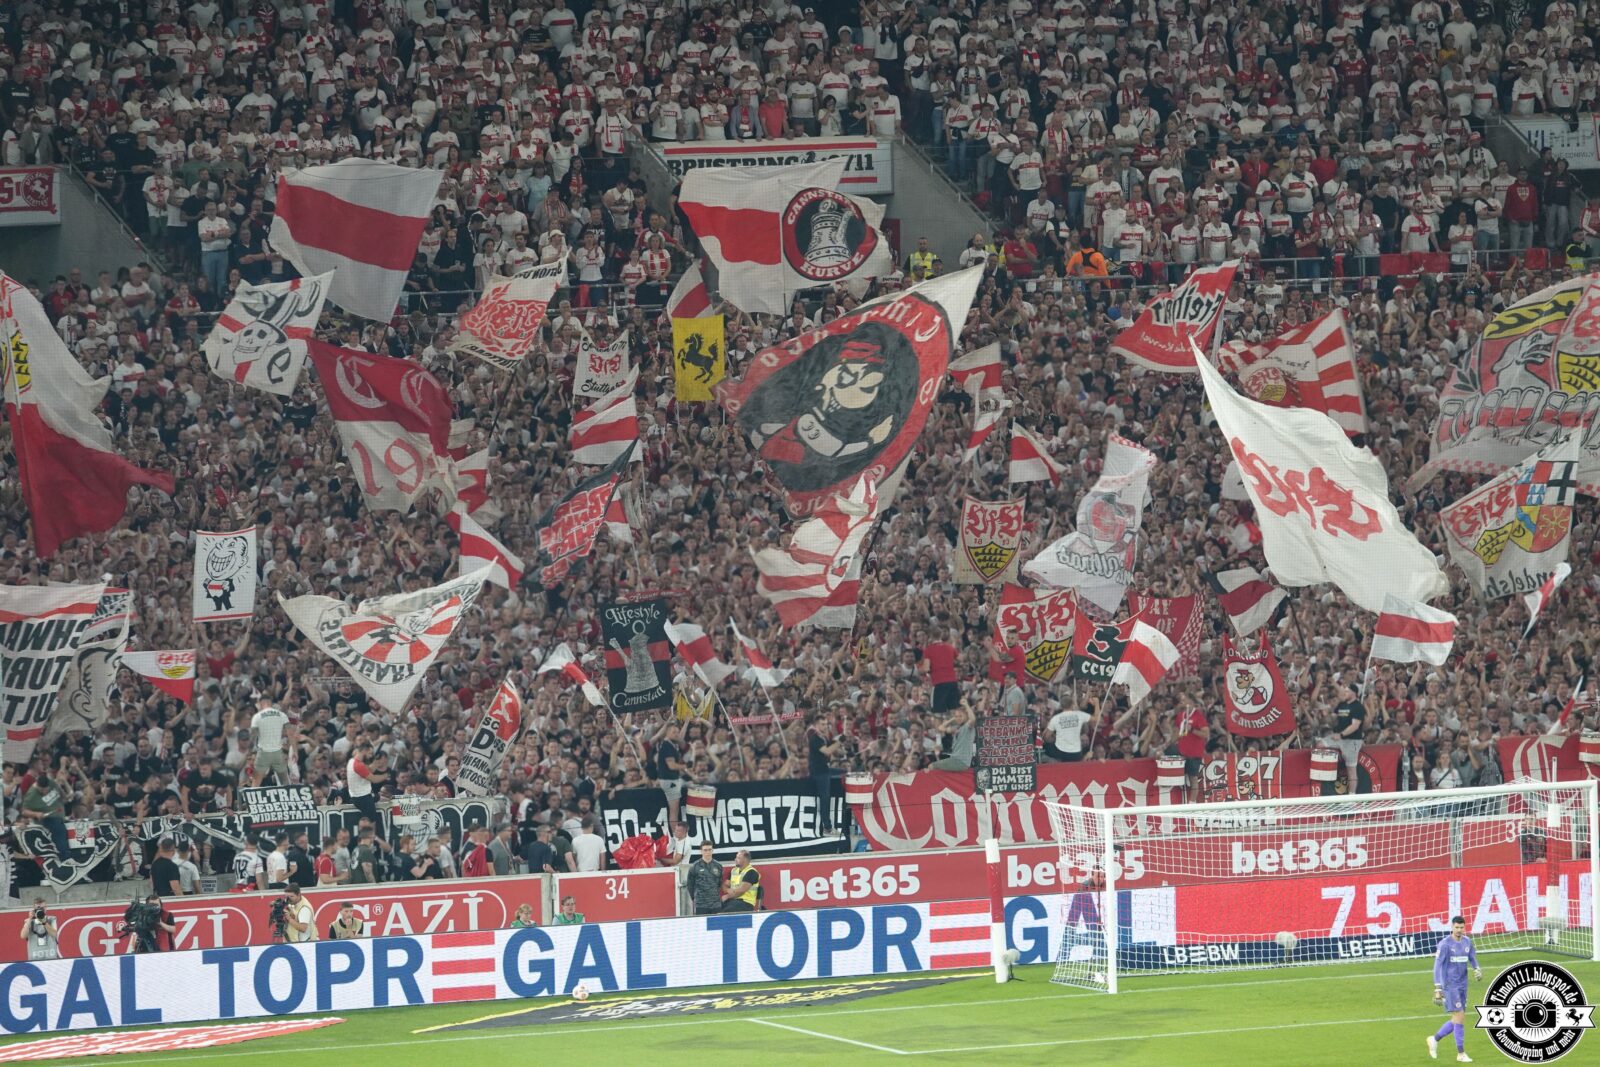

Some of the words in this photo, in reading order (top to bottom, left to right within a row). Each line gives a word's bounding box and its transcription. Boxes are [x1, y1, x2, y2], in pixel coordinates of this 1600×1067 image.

[800, 251, 864, 277] KURVE
[589, 353, 622, 375] VfB
[965, 503, 1023, 538] VfB
[606, 604, 660, 627] Lifestyle
[1000, 591, 1075, 642] VfB
[612, 685, 666, 708] Cannstatt
[1231, 706, 1282, 728] Cannstatt
[984, 735, 1029, 747] KEHRT
[992, 767, 1006, 776] DU
[1011, 766, 1033, 775] BIST
[1237, 756, 1280, 780] 97
[992, 775, 1033, 784] IMMER
[992, 784, 1008, 792] BEI
[1011, 783, 1034, 792] UNS!
[1372, 783, 1381, 793] 97
[246, 786, 314, 805] ULTRAS
[1311, 785, 1321, 797] 19
[249, 799, 315, 814] BEDEUTET
[251, 809, 318, 824] WIDERSTAND
[604, 806, 674, 855] 50+1
[1232, 836, 1368, 874] bet365
[605, 877, 630, 900] 34
[780, 865, 920, 902] bet365
[1321, 883, 1402, 937] 75
[32, 949, 56, 957] FOTO
[0, 955, 162, 1033] GAL
